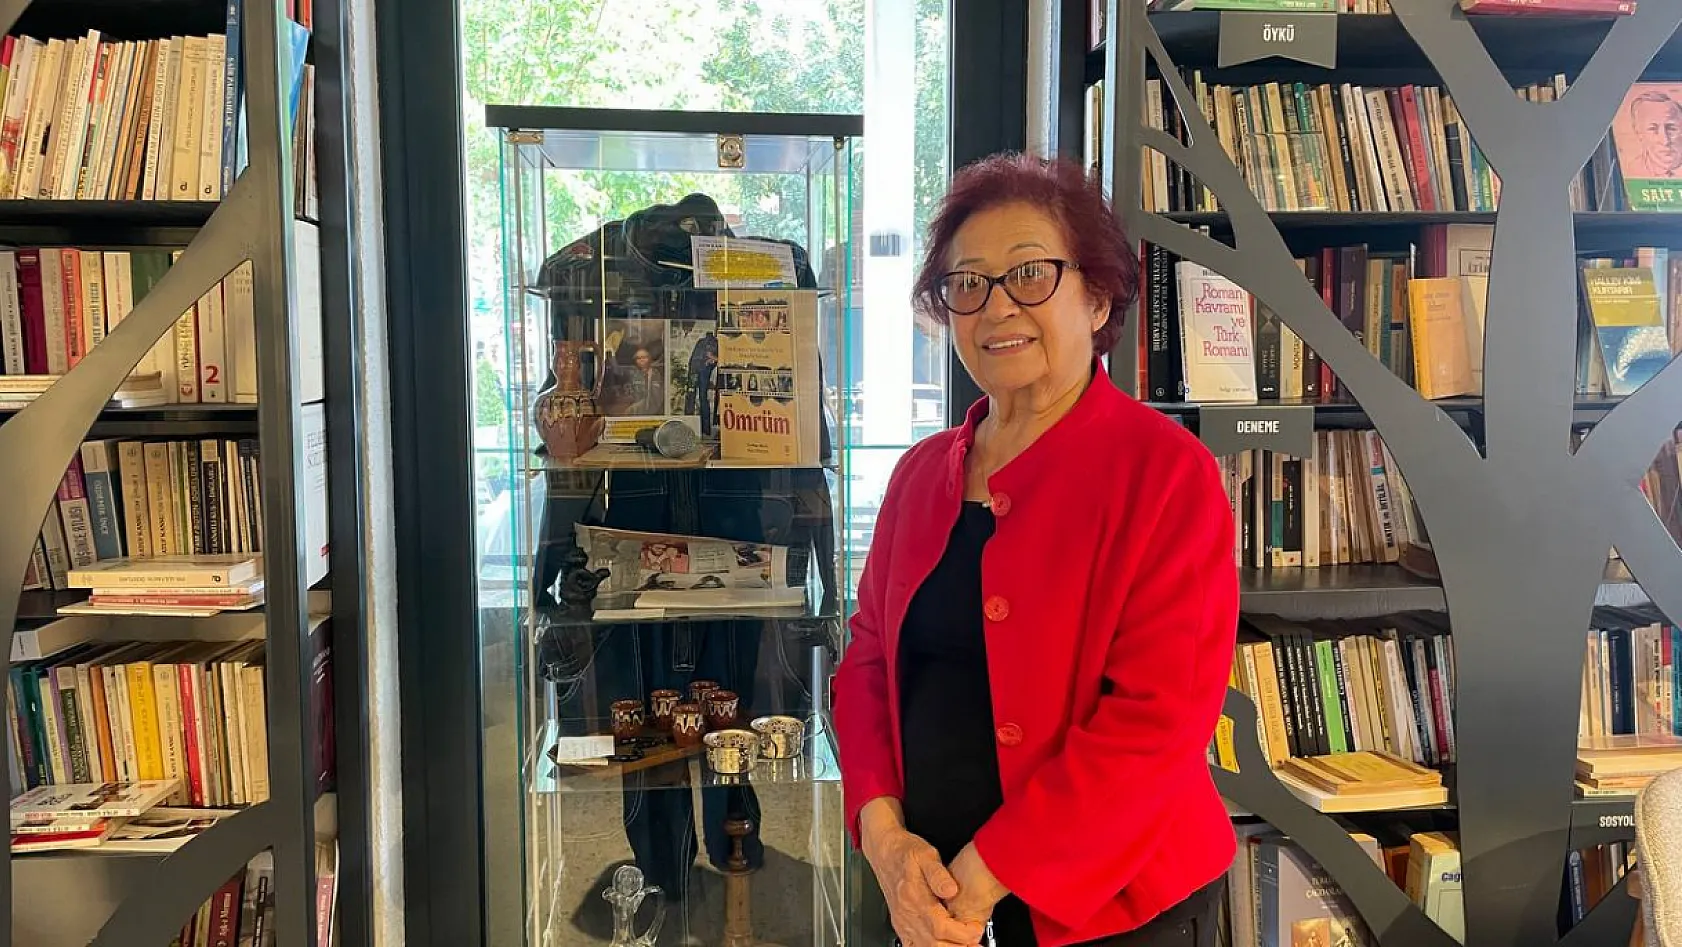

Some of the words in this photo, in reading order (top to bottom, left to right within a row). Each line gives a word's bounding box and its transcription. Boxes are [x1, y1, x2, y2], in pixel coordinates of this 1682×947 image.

[1263, 24, 1296, 42] ÖYKÜ
[1202, 282, 1242, 300] Roman
[1195, 298, 1243, 314] Kavramı
[1231, 318, 1245, 328] ve
[1202, 340, 1249, 357] Romanı
[205, 365, 220, 384] 2
[723, 403, 790, 435] Ömrüm
[1236, 420, 1280, 434] DENEME
[1599, 815, 1635, 828] SOSYOL
